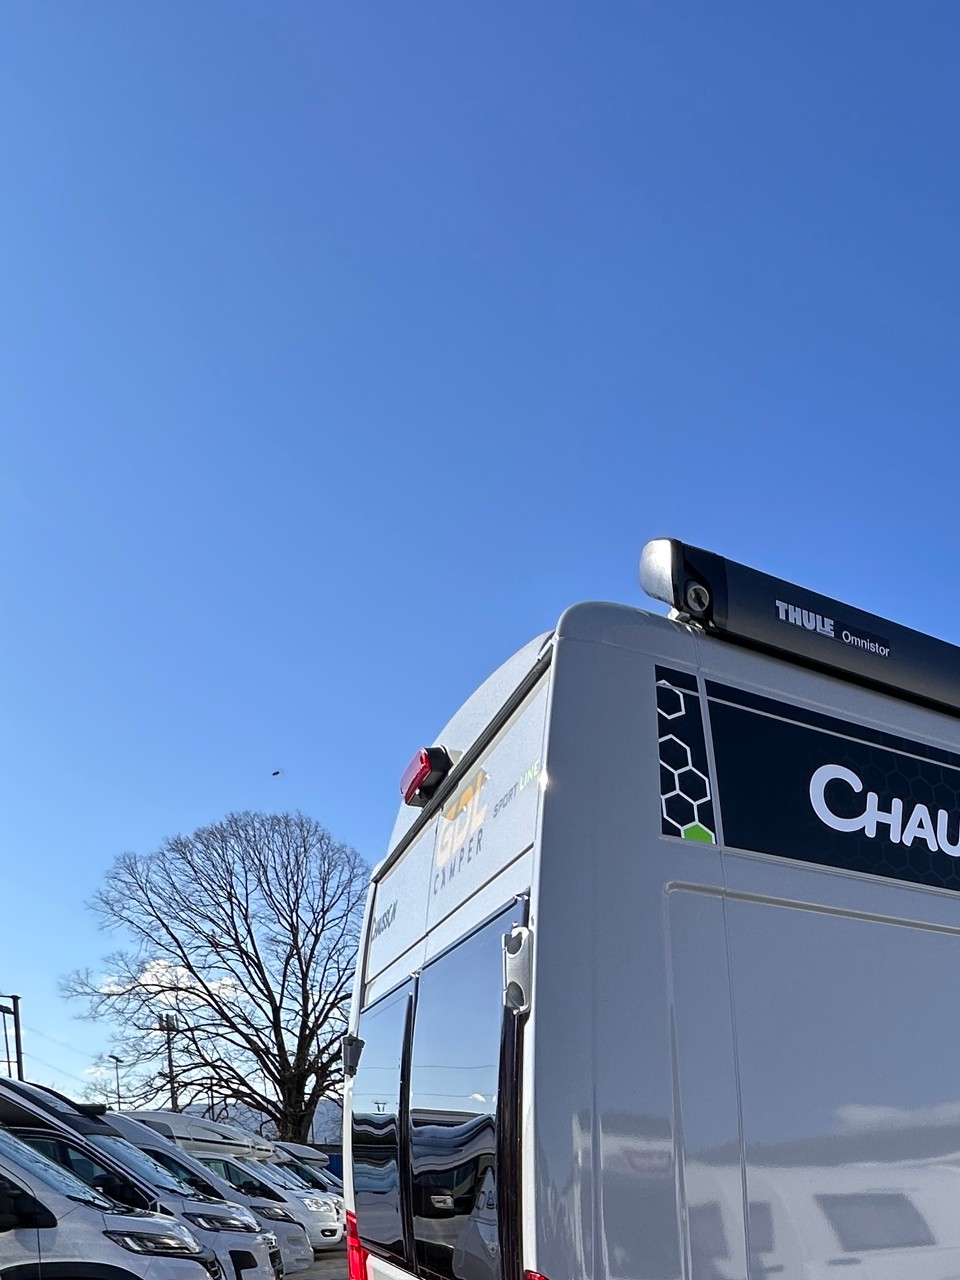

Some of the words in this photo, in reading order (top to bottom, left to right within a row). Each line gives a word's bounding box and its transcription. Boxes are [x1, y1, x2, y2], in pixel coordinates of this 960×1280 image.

[775, 599, 835, 638] THULE
[841, 630, 890, 657] Omnistor
[434, 827, 483, 896] CAMPER
